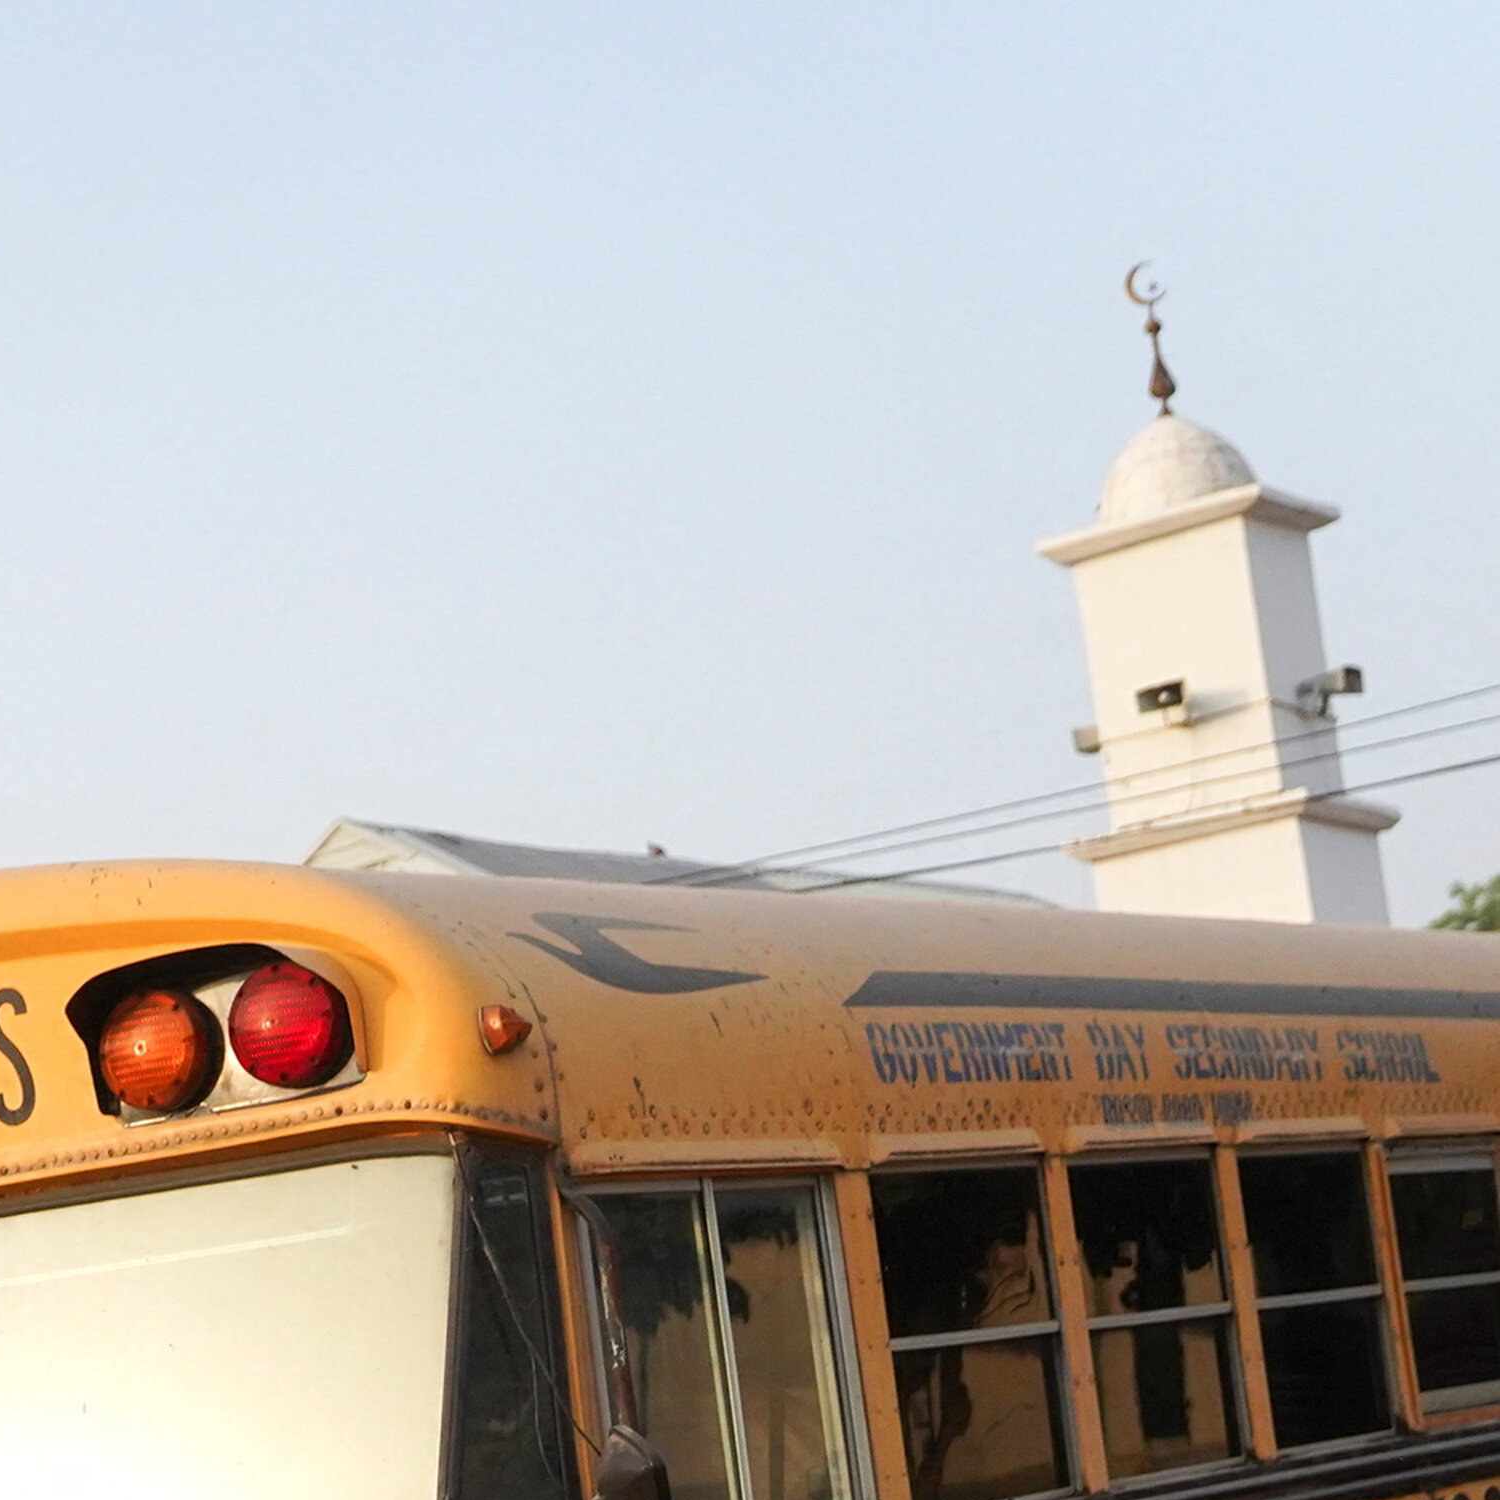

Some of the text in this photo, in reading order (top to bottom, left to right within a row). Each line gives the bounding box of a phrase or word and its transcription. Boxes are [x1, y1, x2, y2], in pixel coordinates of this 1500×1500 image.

[865, 1022, 1440, 1084] GOVERNMENT DAY SECONDARY SCHOOL
